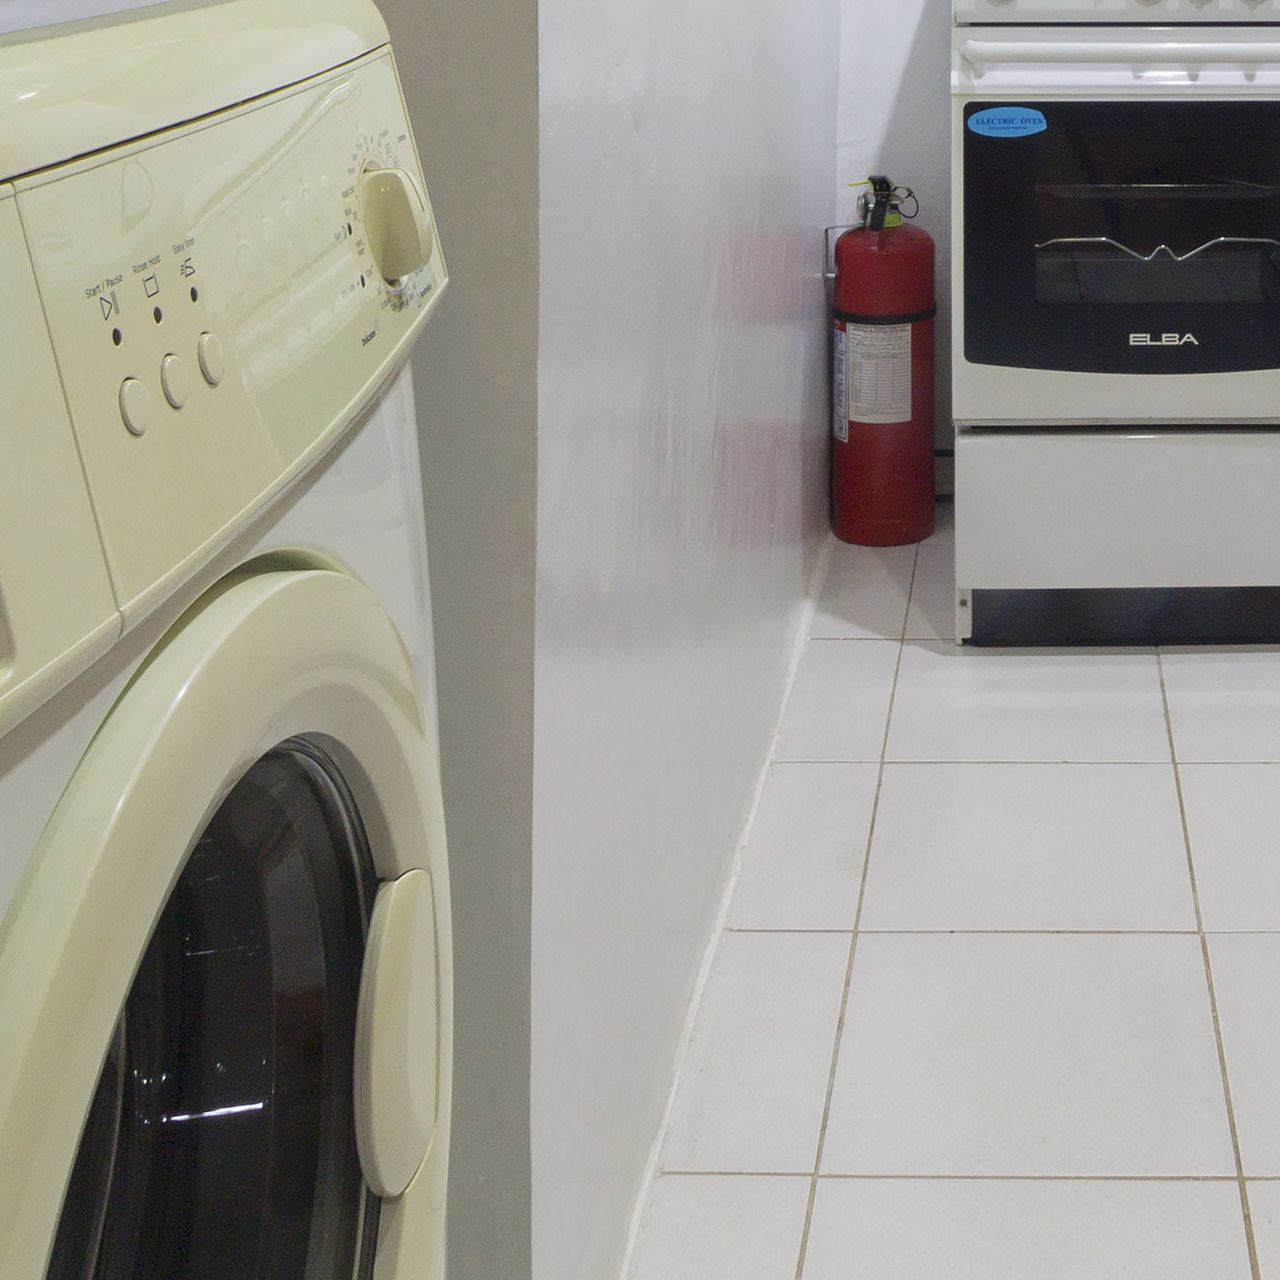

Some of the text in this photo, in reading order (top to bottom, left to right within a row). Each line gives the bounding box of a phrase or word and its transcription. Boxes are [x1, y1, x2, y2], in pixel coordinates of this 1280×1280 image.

[976, 116, 1044, 126] ELECTRIC OVEN
[84, 284, 101, 299] Start
[1129, 332, 1200, 346] ELBA
